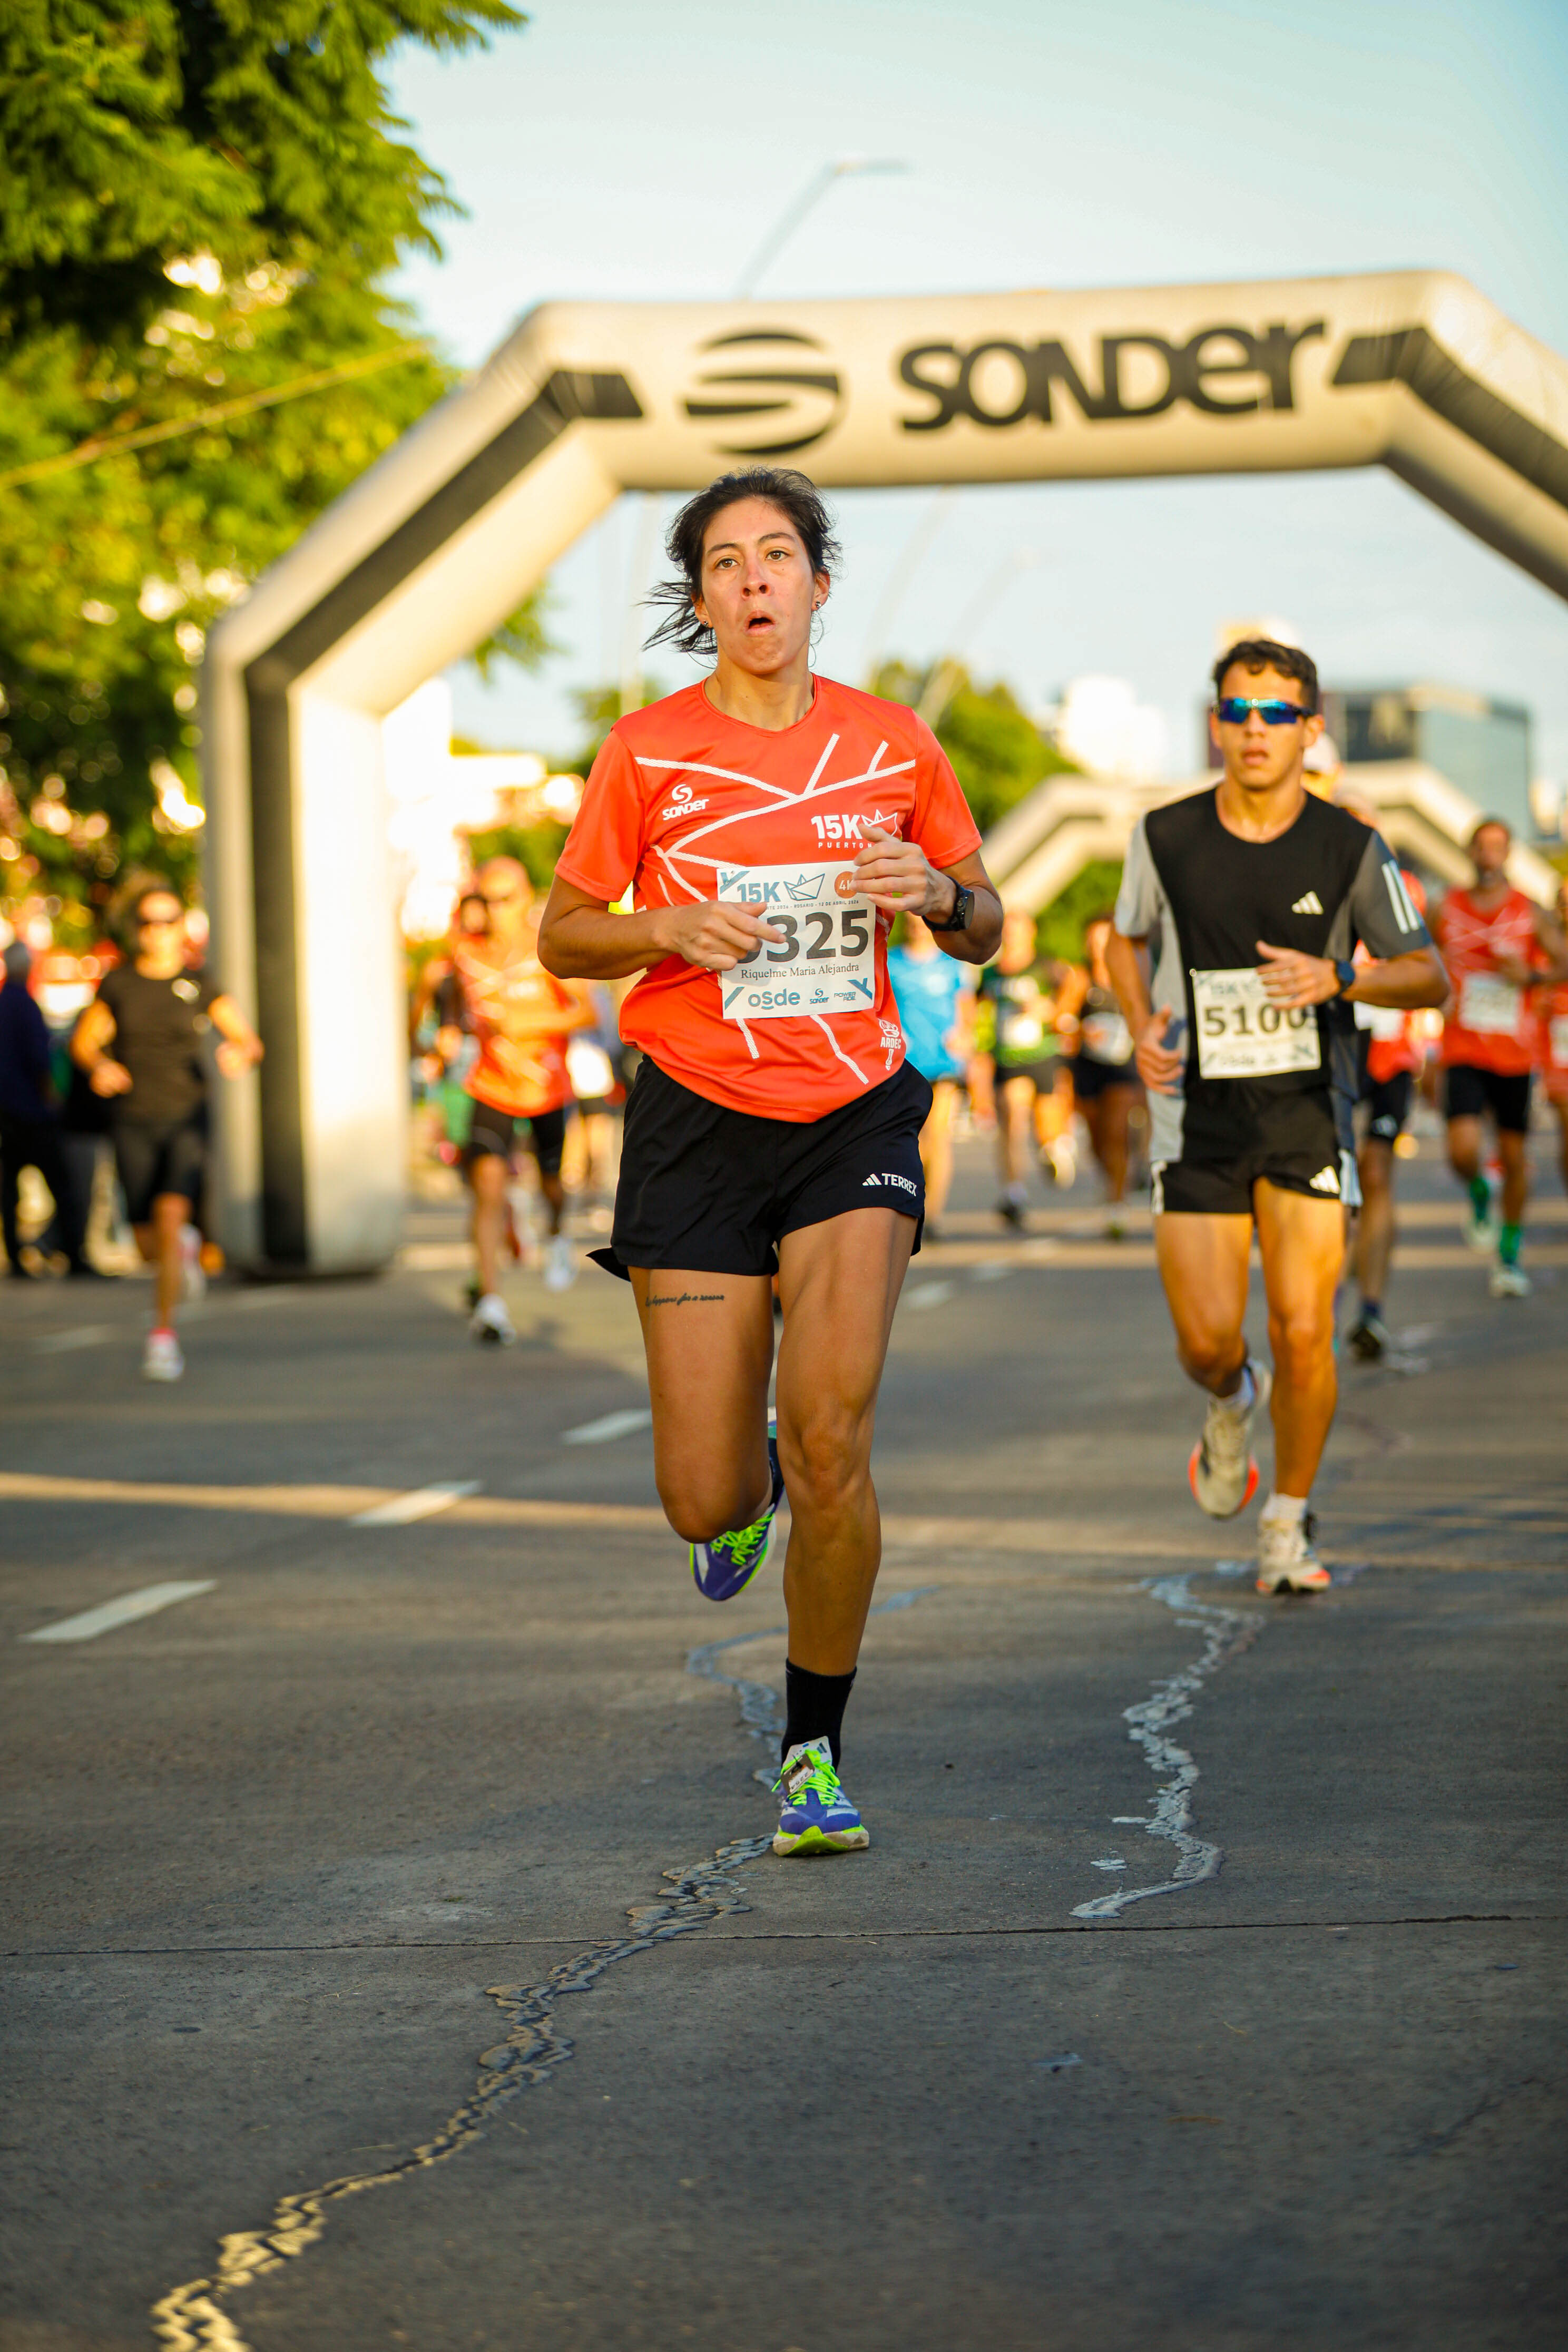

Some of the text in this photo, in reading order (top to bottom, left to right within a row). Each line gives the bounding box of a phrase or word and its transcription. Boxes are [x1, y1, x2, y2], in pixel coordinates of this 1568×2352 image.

[810, 814, 863, 839] 15K
[737, 881, 781, 903] 15K
[737, 909, 869, 964] 325
[741, 963, 860, 981] Riquelme Maria Alejandra
[748, 988, 801, 1010] osde
[1203, 1002, 1307, 1037] 5100
[880, 1036, 901, 1050] ARDEC
[881, 1173, 917, 1197] TERREX
